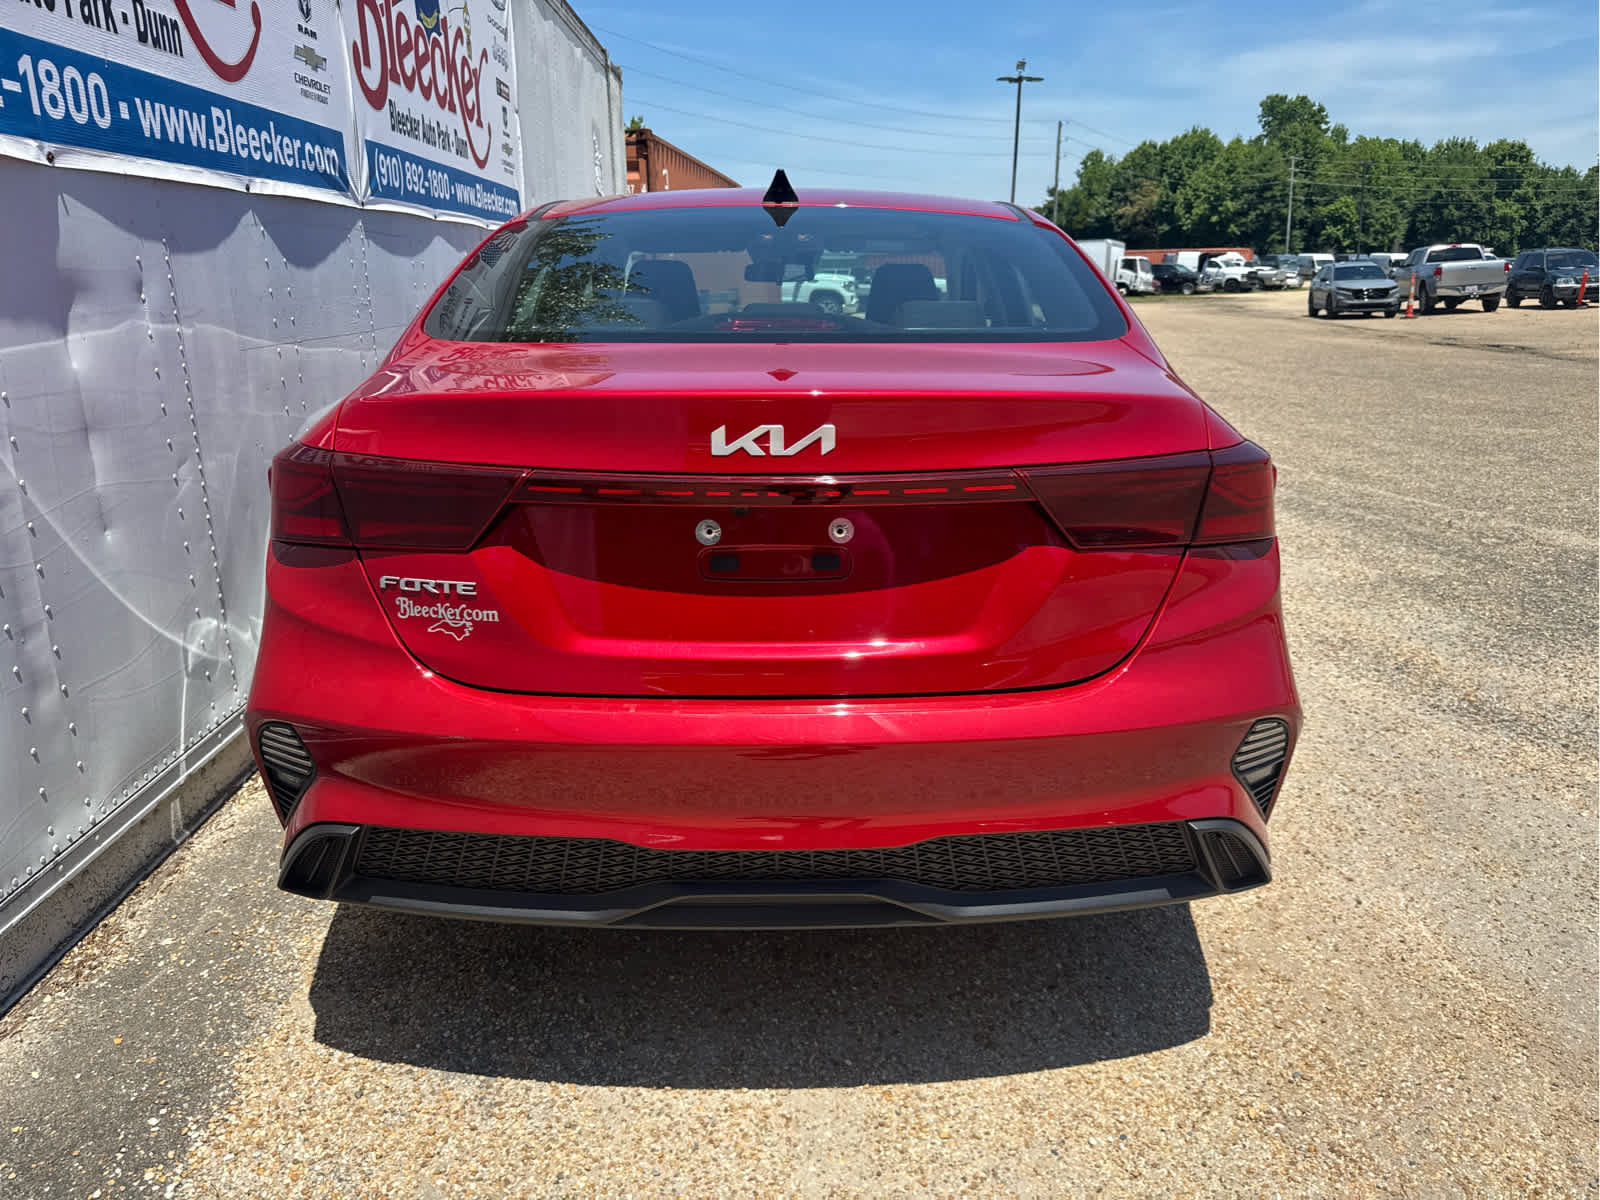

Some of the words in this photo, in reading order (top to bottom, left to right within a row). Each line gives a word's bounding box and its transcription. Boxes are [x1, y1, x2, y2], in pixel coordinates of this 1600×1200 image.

[132, 0, 184, 58] Dunn
[297, 23, 318, 40] RAM
[294, 72, 331, 95] CHEVROLET
[0, 54, 111, 129] -1800
[134, 97, 339, 177] www.Bleecker.com
[388, 99, 420, 142] Bleecker
[421, 113, 437, 148] Auto
[436, 121, 452, 153] Park
[453, 128, 469, 160] Dunn
[374, 148, 404, 196] (910)
[404, 161, 450, 200] 892-1800
[455, 182, 518, 217] www.Bleecker.com
[711, 424, 836, 456] KIA
[379, 575, 477, 596] FORTE
